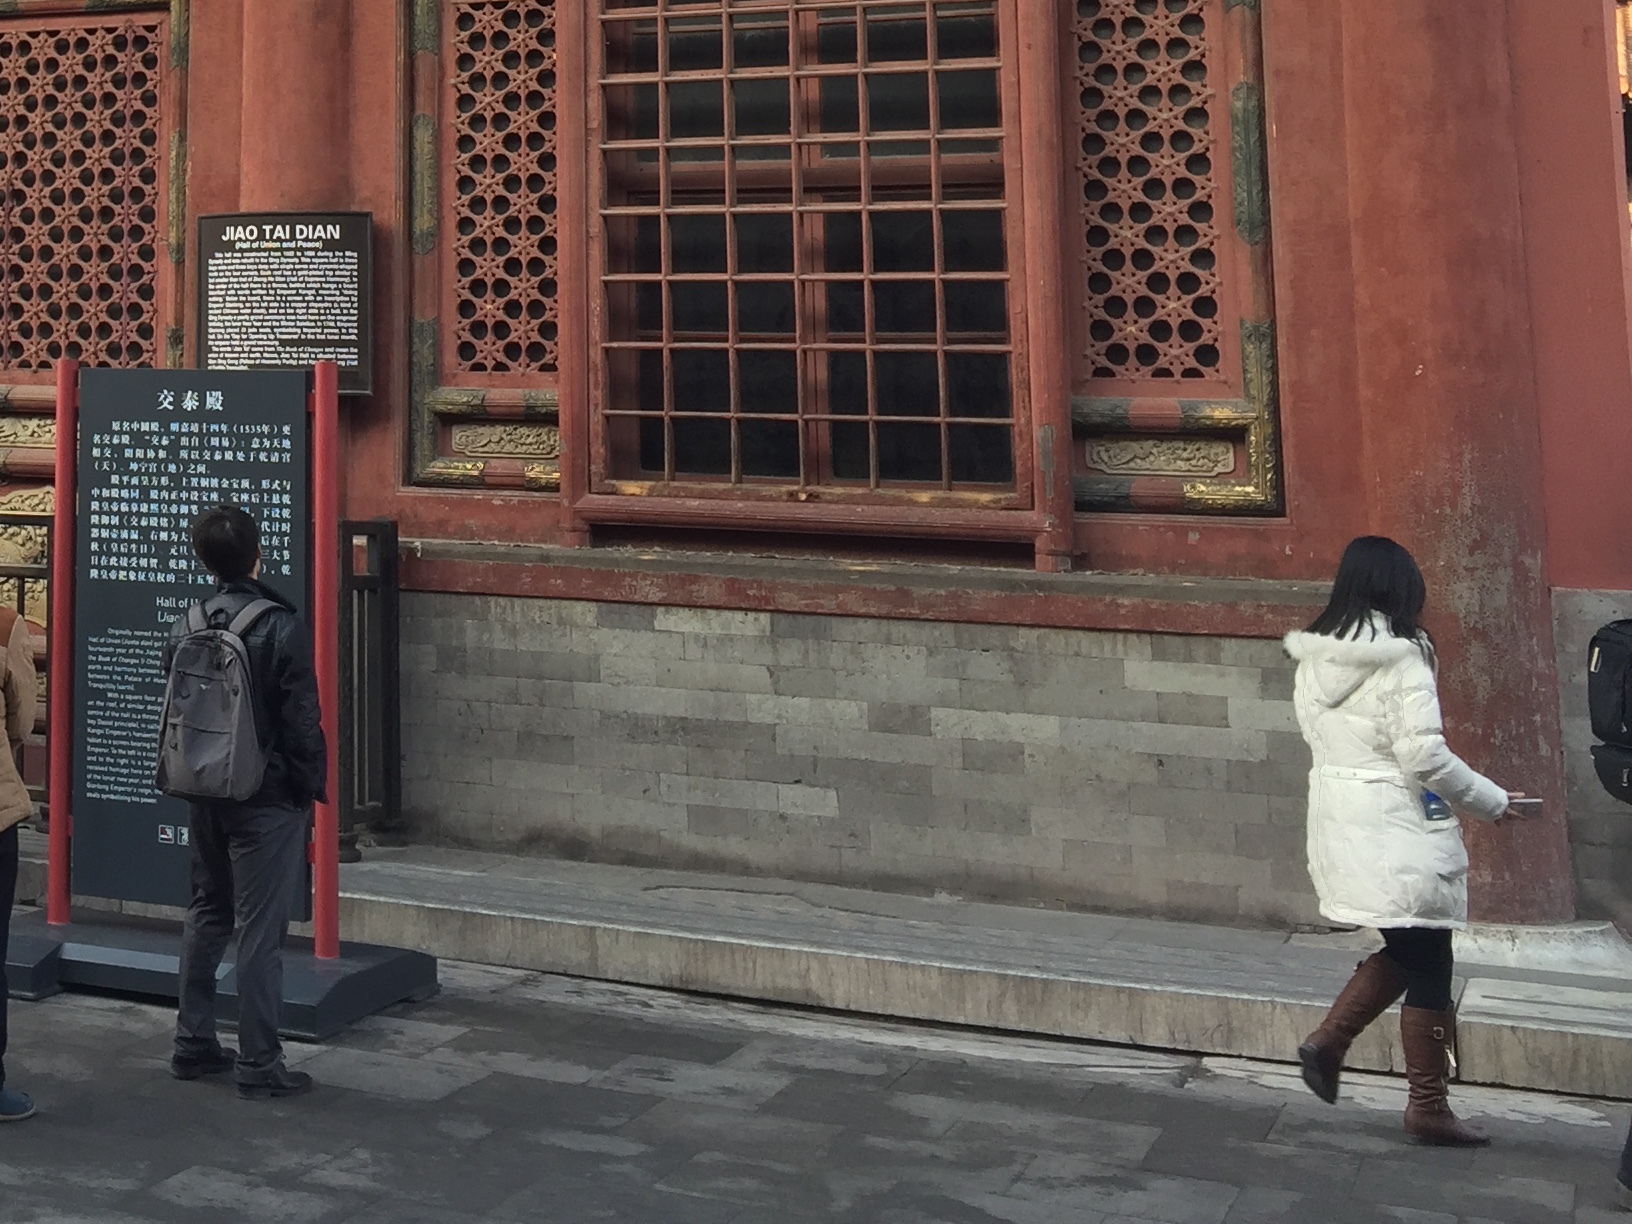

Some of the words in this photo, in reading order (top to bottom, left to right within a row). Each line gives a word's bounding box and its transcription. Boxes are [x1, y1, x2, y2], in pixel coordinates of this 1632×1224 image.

[221, 225, 258, 241] JIAO
[262, 224, 290, 240] TAI
[295, 224, 340, 240] DIAN
[157, 389, 224, 412] 交泰殿
[156, 596, 176, 608] Hall
[178, 597, 188, 608] of
